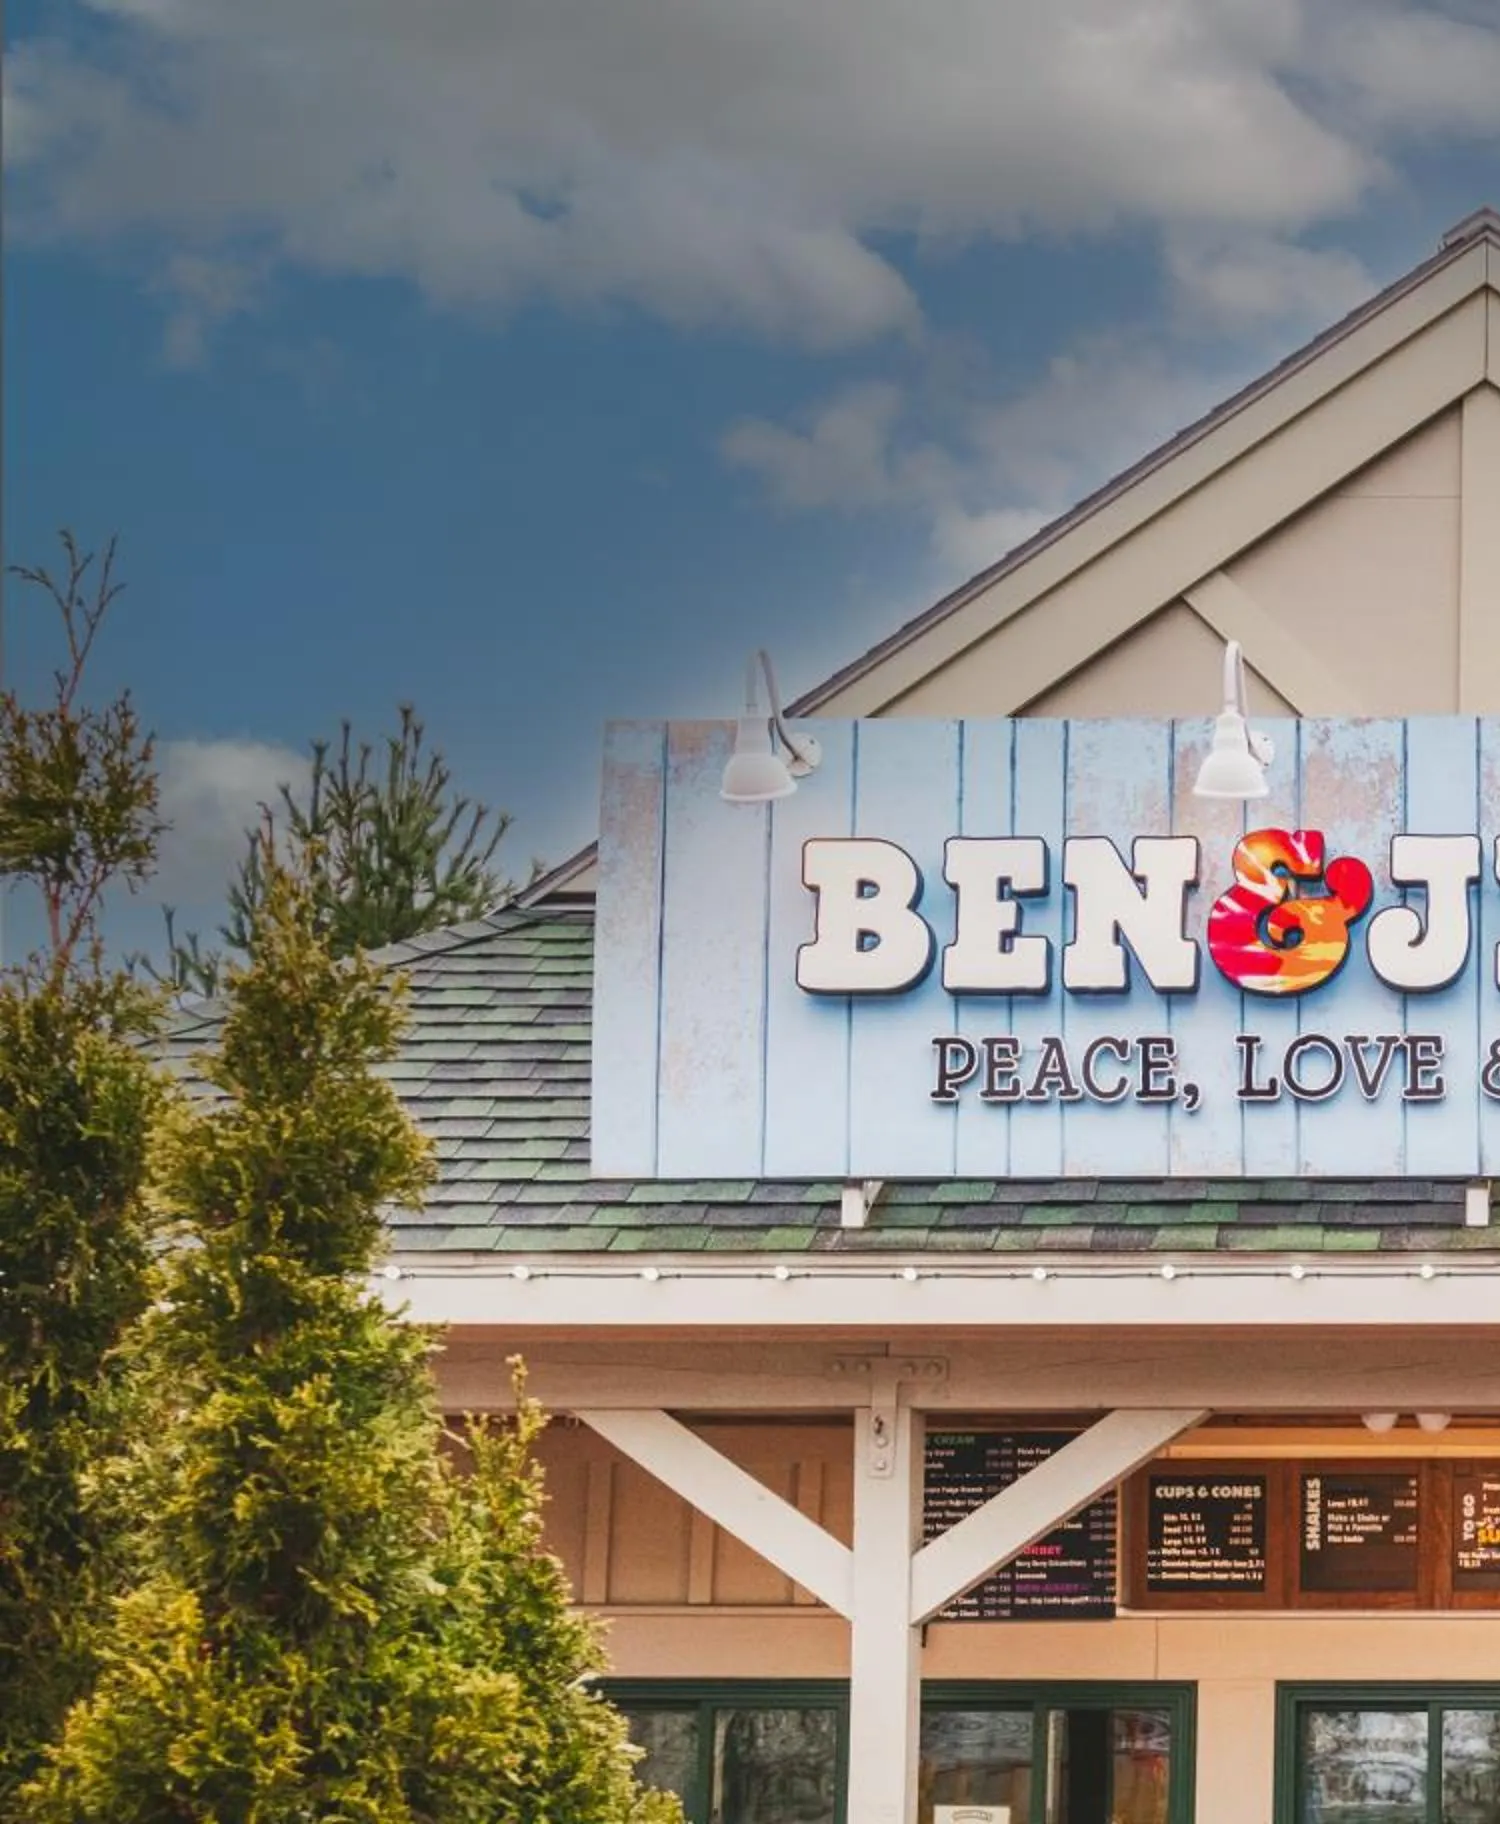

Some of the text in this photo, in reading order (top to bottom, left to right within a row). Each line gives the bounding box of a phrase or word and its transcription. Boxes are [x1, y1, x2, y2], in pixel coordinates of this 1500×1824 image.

[930, 1035, 1201, 1110] PEACE,
[1235, 1034, 1446, 1102] LOVE
[1155, 1485, 1262, 1499] CUPS & CONES
[1306, 1477, 1321, 1551] SHAKES
